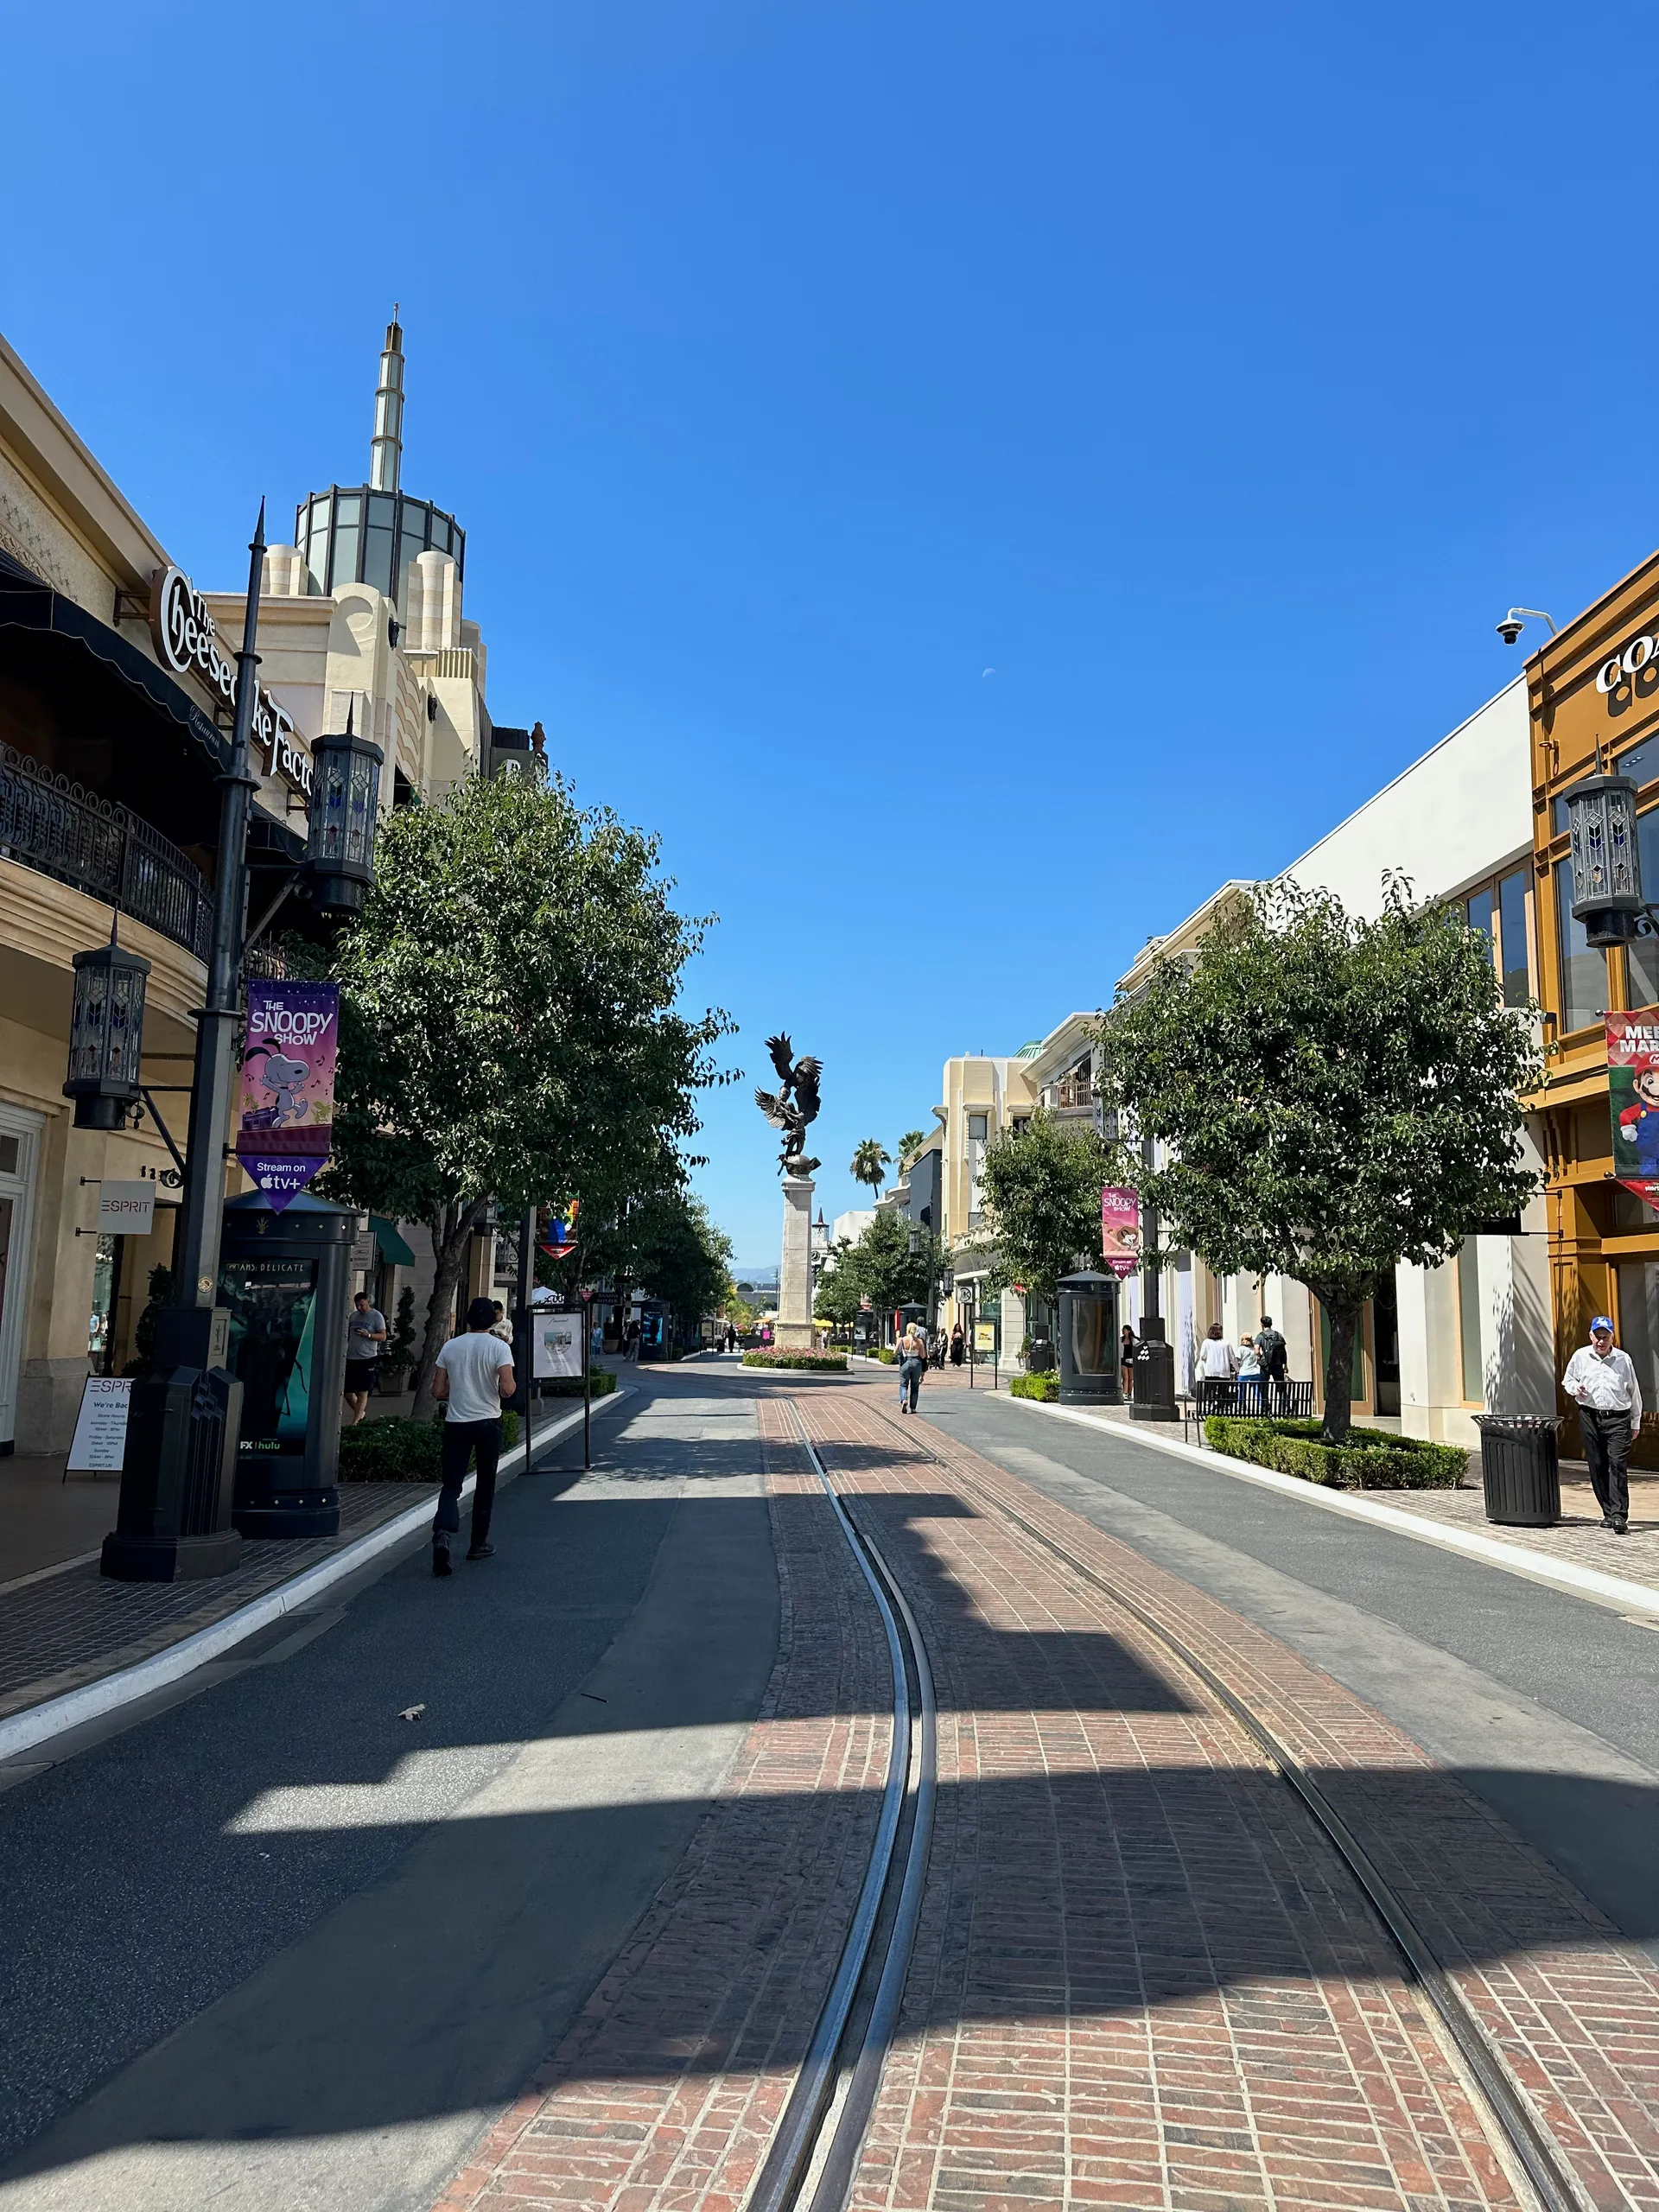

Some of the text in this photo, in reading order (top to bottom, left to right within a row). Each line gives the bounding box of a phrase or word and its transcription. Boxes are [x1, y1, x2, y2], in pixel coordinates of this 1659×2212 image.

[193, 589, 216, 637] The
[1595, 635, 1659, 694] CO
[160, 566, 313, 797] Cheesecke Facto
[263, 1000, 284, 1011] THE
[250, 1010, 334, 1034] SNOOPY
[274, 1031, 318, 1046] SHOW
[257, 1162, 306, 1173] Stream on
[101, 1199, 151, 1213] ESPRIT
[1103, 1197, 1136, 1208] SNOOPY
[260, 1263, 304, 1272] DELICATE
[90, 1380, 132, 1393] ESPR
[239, 1440, 281, 1450] FX hulu
